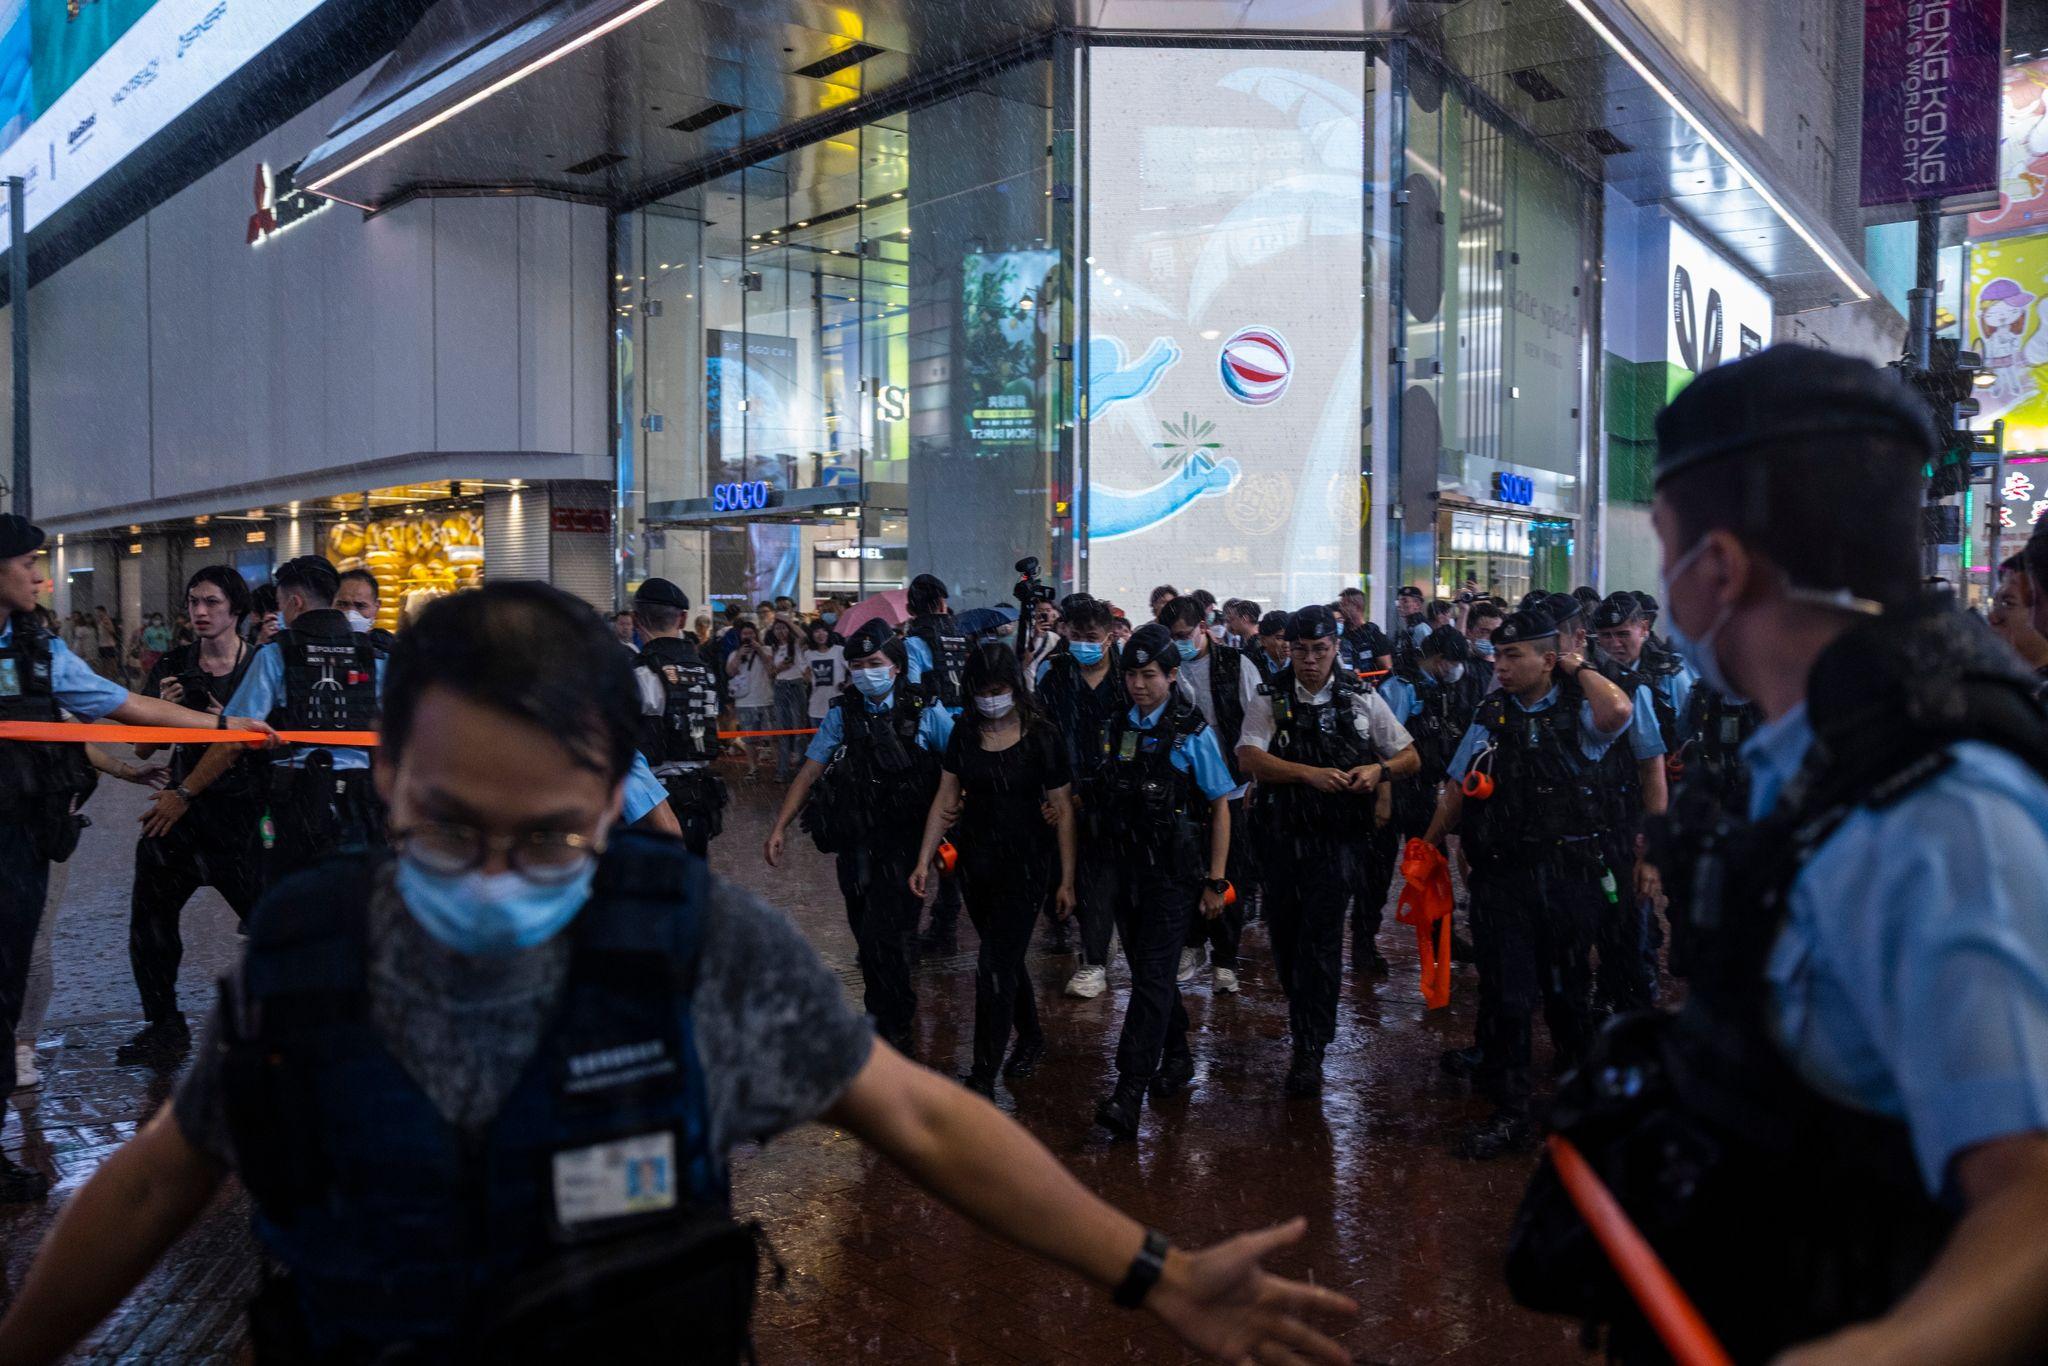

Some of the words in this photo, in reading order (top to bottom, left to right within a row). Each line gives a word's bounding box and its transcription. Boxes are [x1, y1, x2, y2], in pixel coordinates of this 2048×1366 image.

[1905, 0, 1923, 55] SIA'S
[1903, 59, 1922, 134] WORLD
[1920, 86, 1949, 184] KONG
[1901, 138, 1920, 184] CITY
[877, 386, 909, 423] S
[713, 479, 768, 512] SOGO
